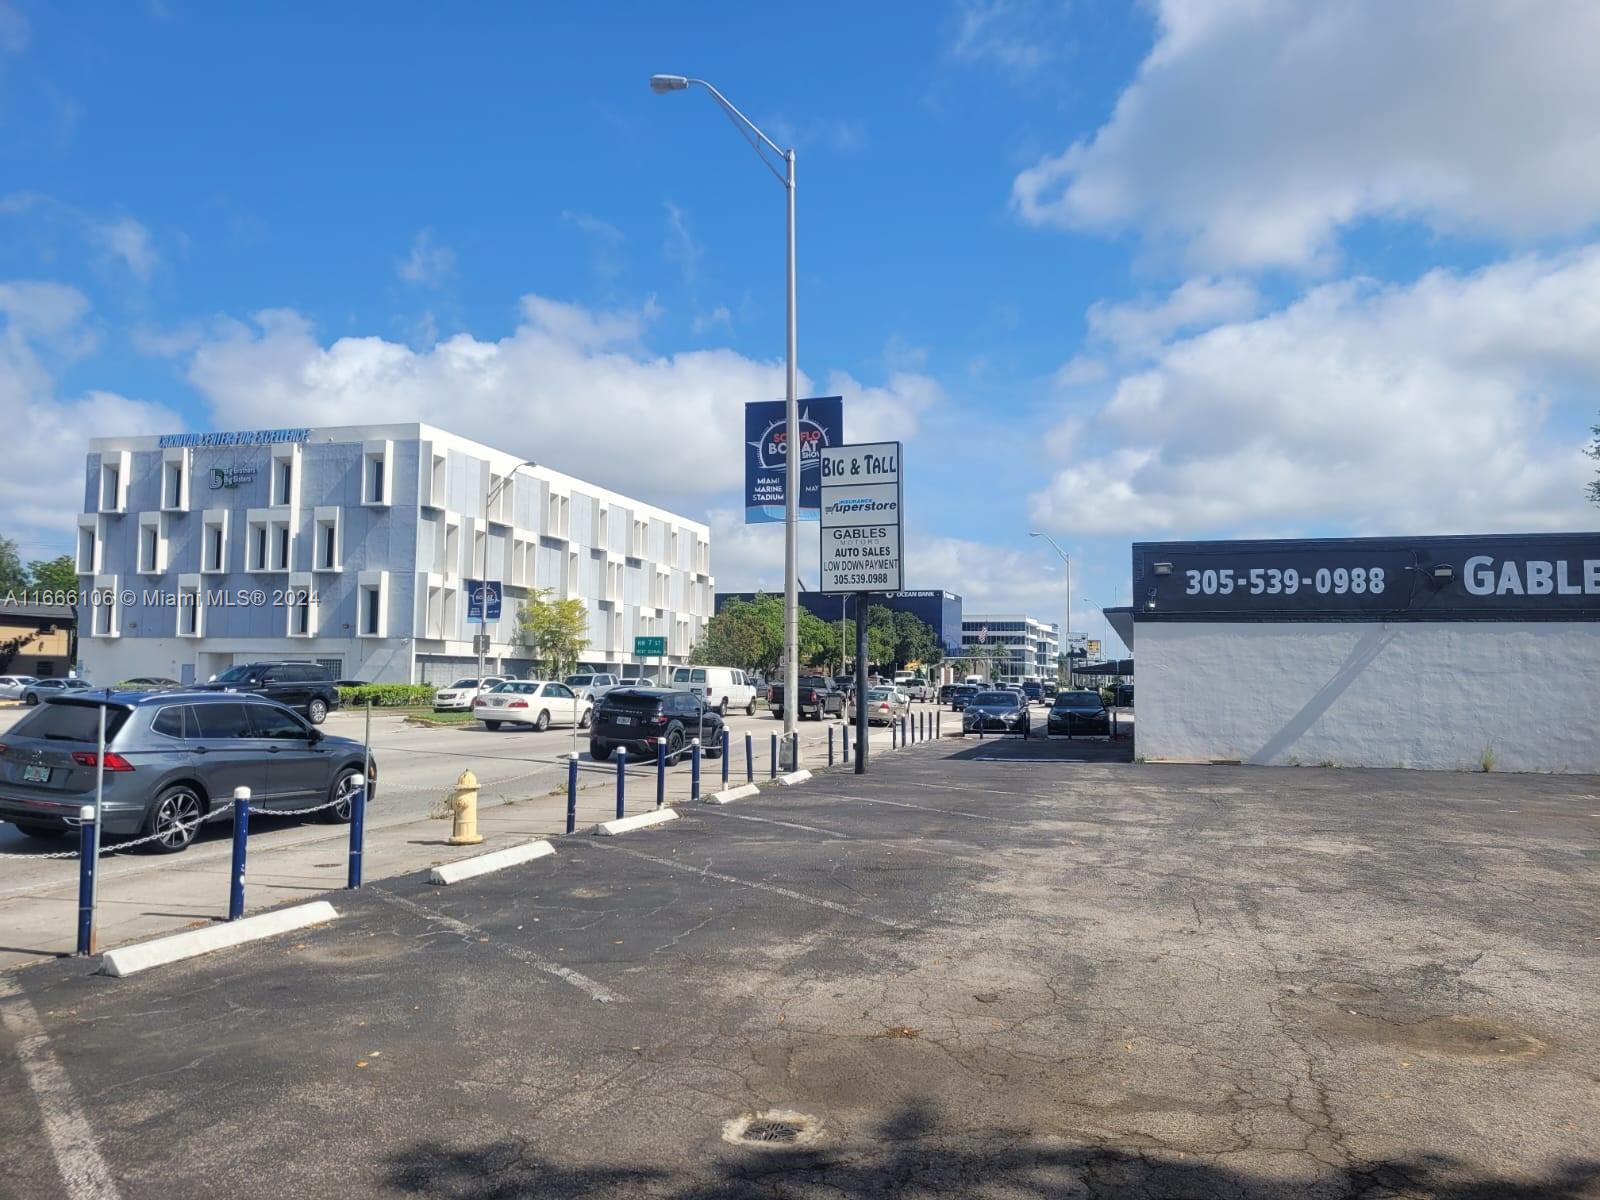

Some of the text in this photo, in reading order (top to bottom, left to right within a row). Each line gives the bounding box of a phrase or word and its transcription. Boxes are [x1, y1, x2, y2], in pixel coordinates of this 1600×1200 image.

[822, 454, 897, 477] BIG & TALL
[754, 485, 783, 493] MARINE
[752, 493, 784, 502] STADIUM
[833, 527, 887, 540] GABLES
[835, 546, 891, 558] AUTO SALES
[824, 558, 898, 571] LOW DOWN PAYMENT
[834, 573, 888, 585] 305.539.0988
[1185, 555, 1600, 595] 305-539-0988 GABLE
